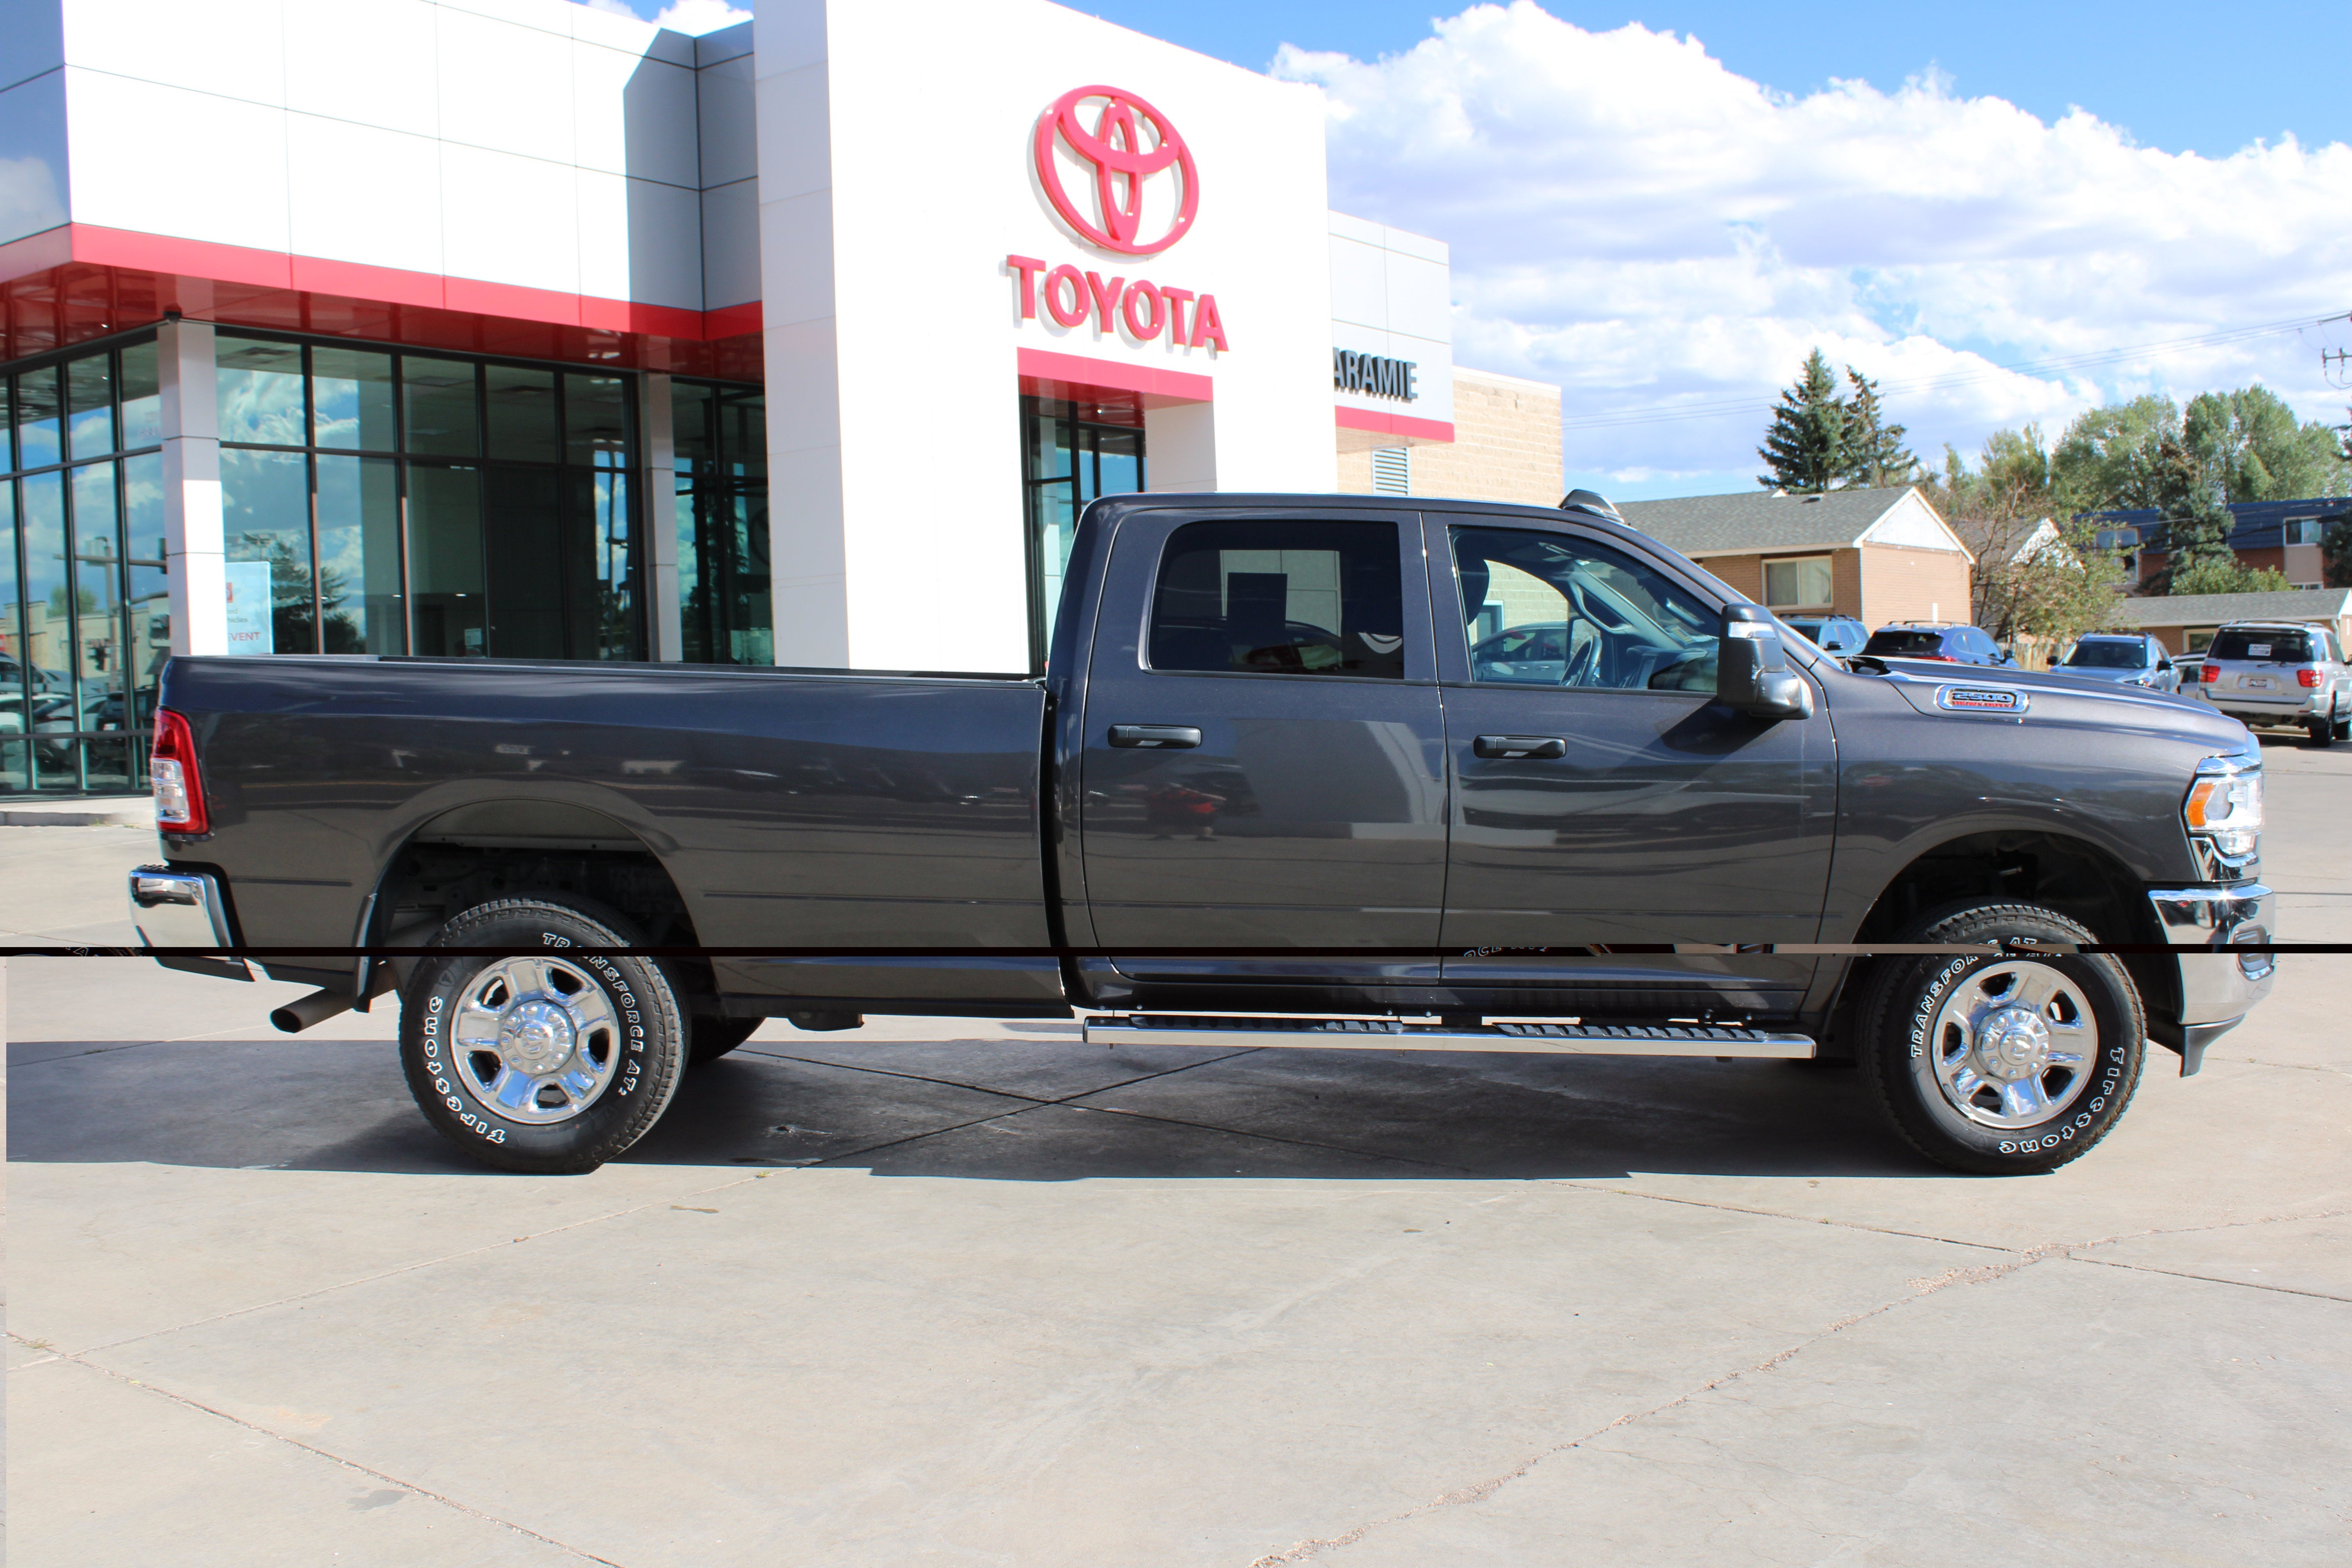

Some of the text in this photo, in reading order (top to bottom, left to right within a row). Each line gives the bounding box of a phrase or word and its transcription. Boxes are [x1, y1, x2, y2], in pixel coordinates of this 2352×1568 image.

[1007, 254, 1229, 352] TOYOTA
[1953, 693, 2013, 702] 2500
[542, 932, 644, 1053] TRNSFORCE
